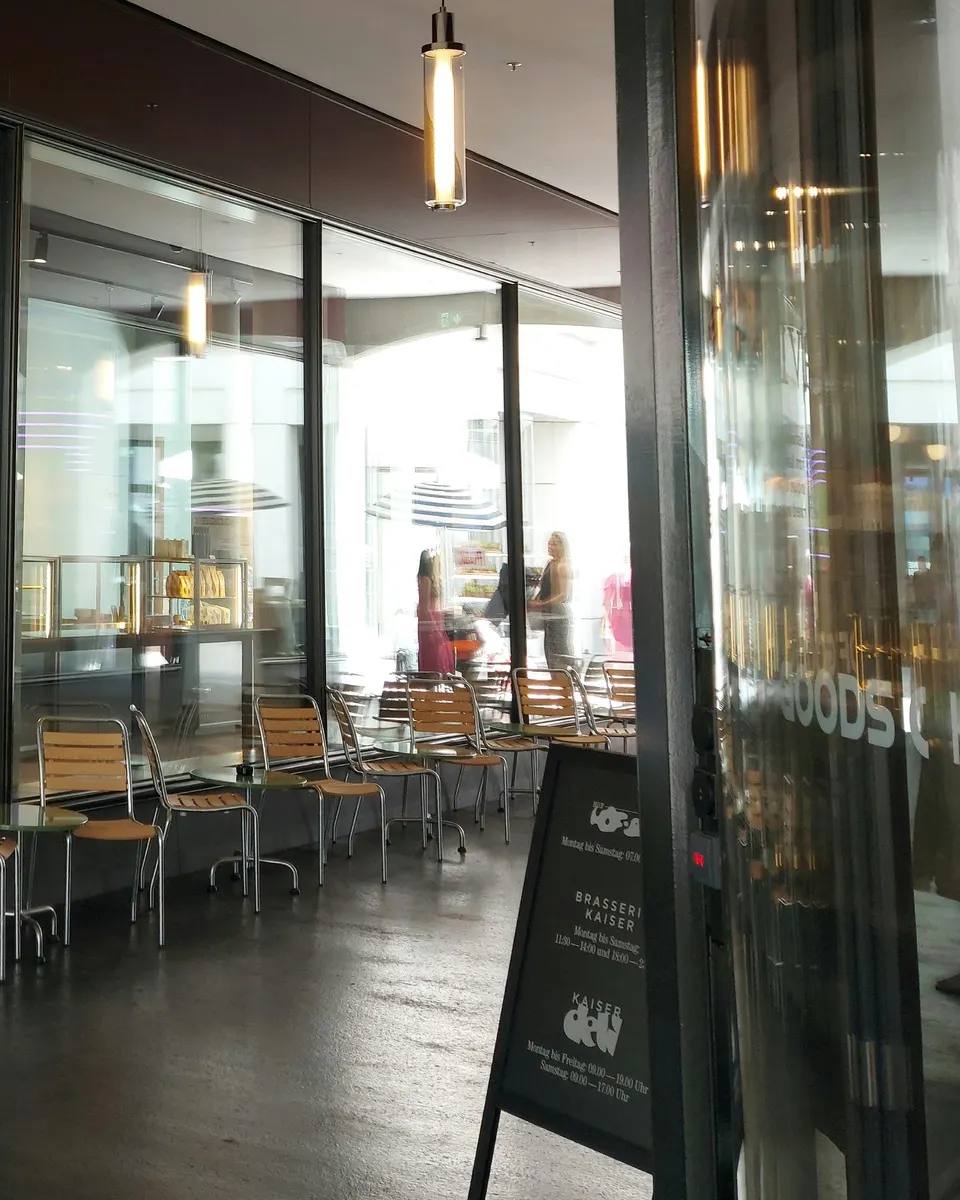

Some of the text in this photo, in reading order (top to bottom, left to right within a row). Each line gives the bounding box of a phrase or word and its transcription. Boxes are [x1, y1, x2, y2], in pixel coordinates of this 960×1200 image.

[561, 836, 584, 851] Montag
[585, 841, 594, 853] bis
[576, 891, 641, 918] BRASSERI
[585, 908, 634, 932] KAISER
[574, 925, 598, 943] Montag
[599, 932, 608, 944] bis
[597, 948, 610, 959] und
[572, 992, 621, 1017] KAISER
[527, 1040, 550, 1059] Montag
[551, 1048, 560, 1061] bis
[634, 1080, 649, 1095] Uhr
[615, 1088, 630, 1103] Uhr
